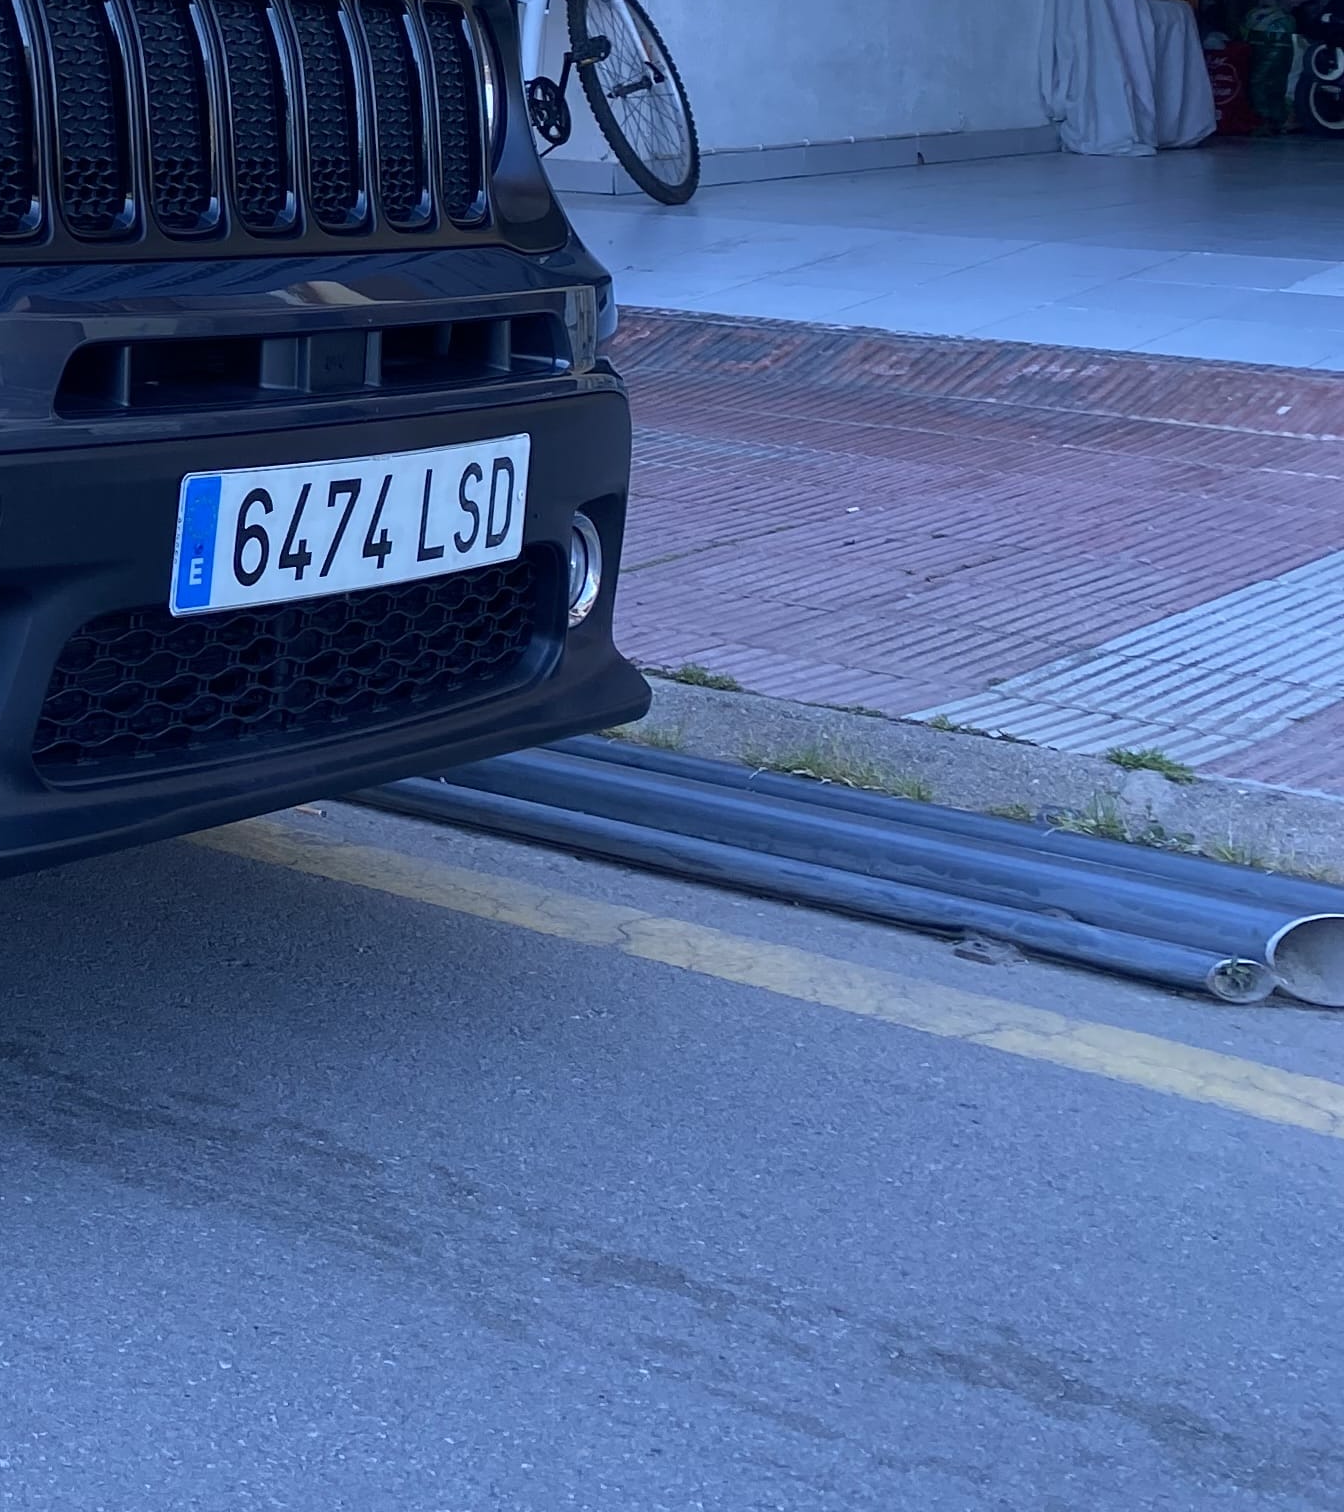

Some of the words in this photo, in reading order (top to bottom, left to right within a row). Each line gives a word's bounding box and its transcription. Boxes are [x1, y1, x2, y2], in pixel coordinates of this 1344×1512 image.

[232, 474, 394, 587] 6474
[417, 456, 516, 563] LSD
[188, 556, 204, 586] E
